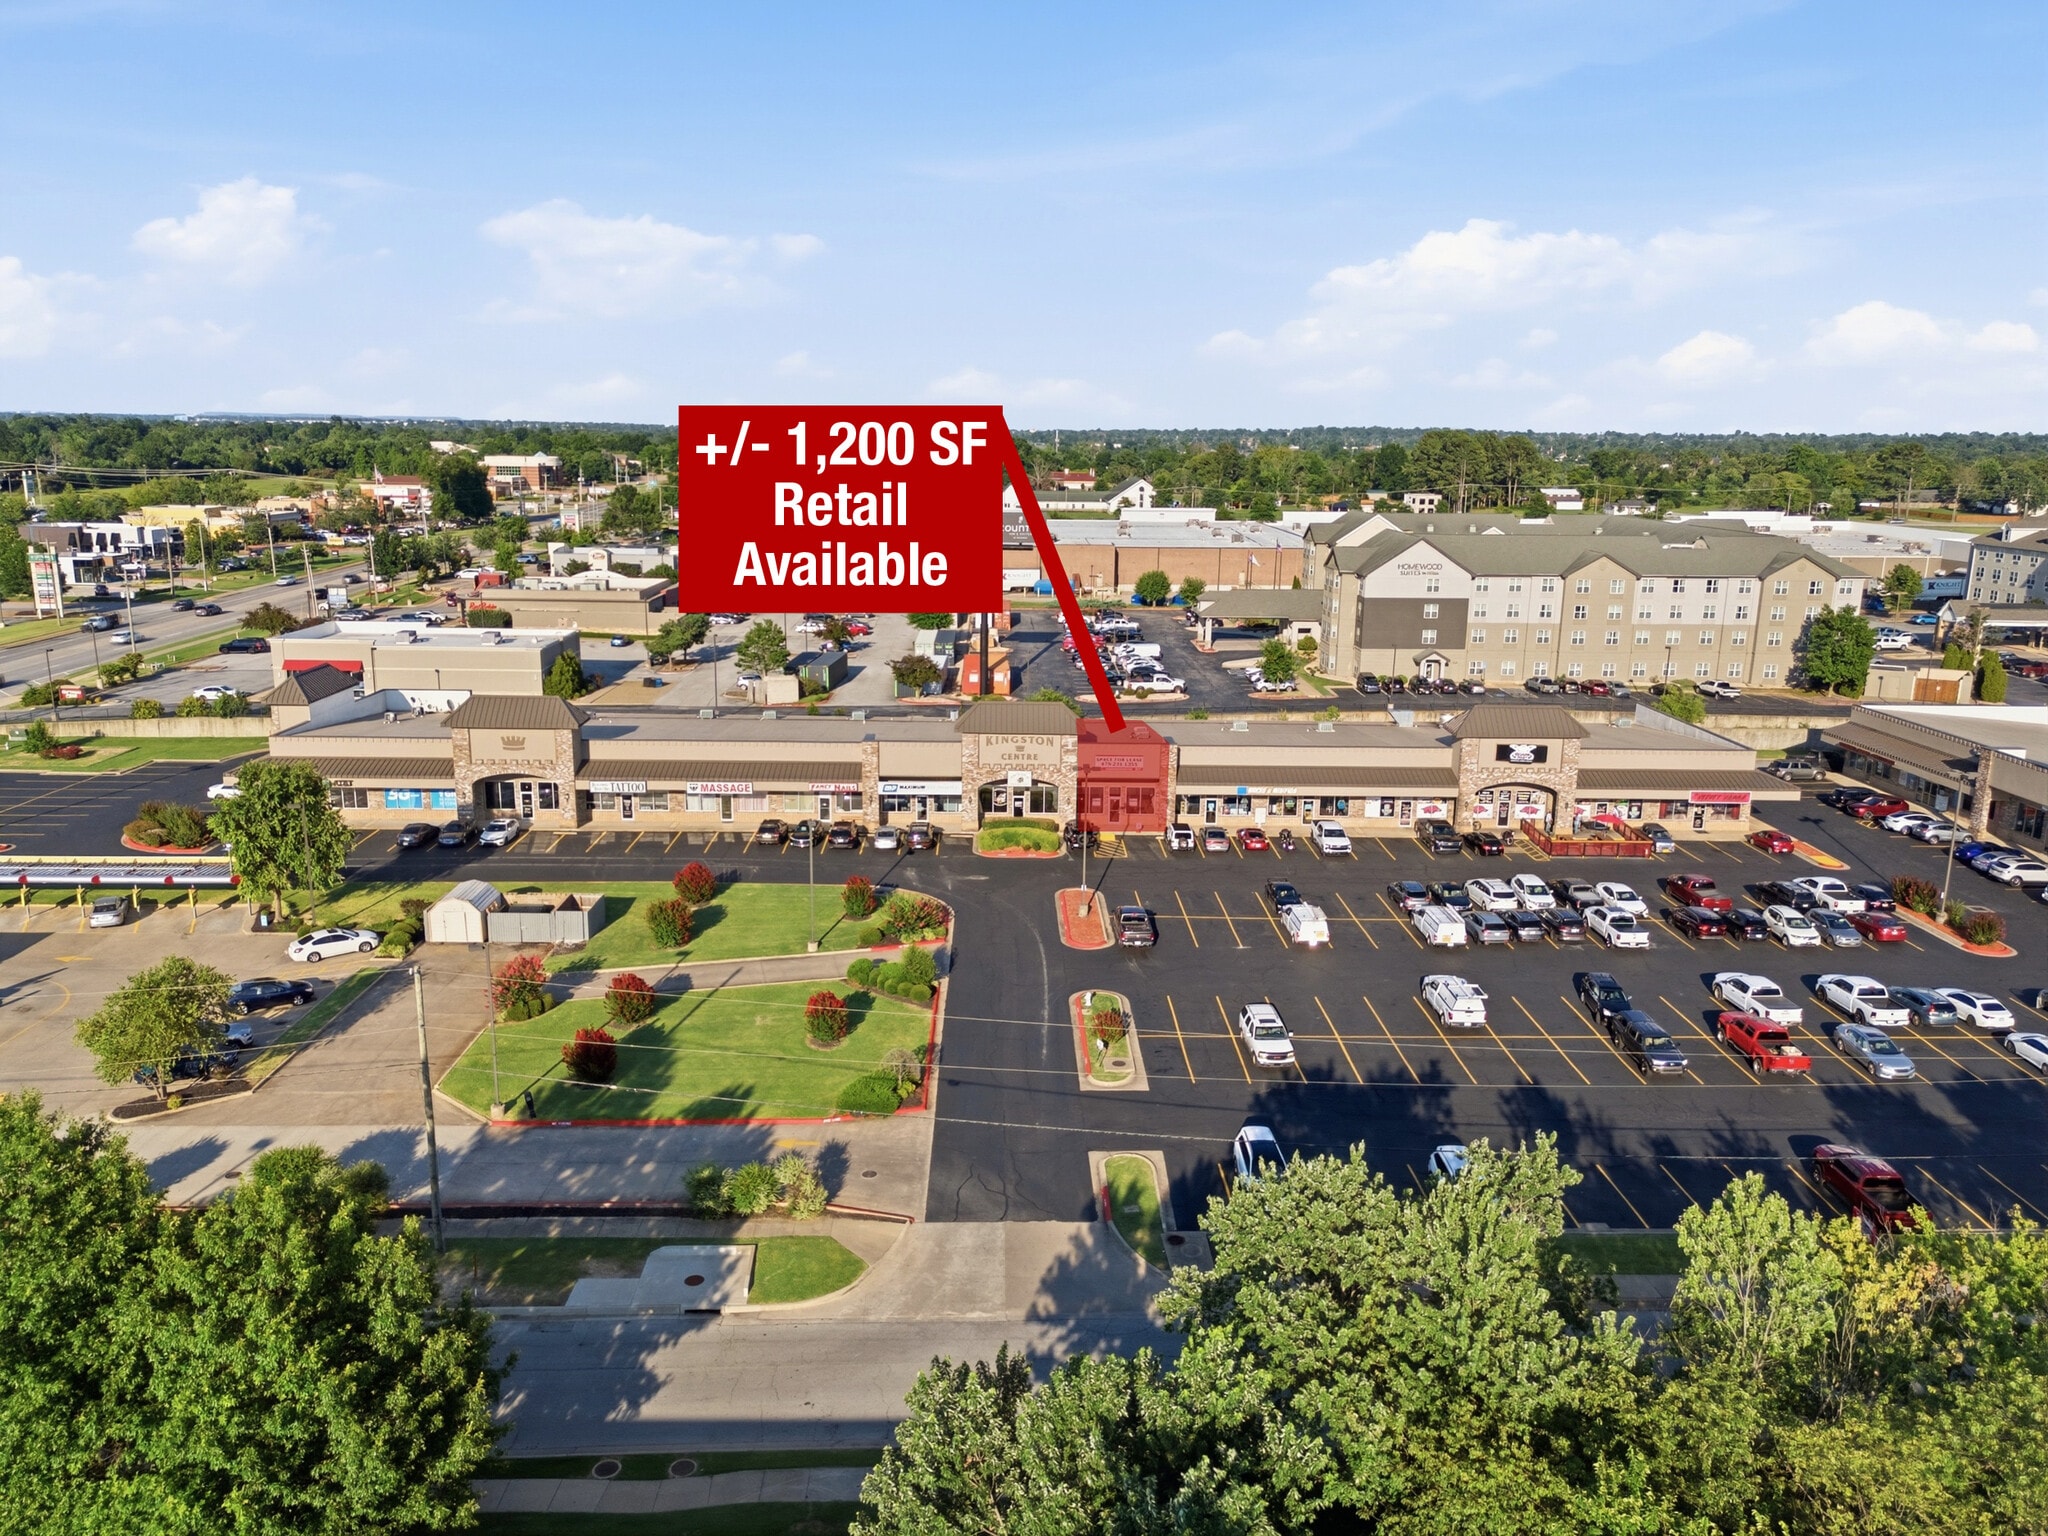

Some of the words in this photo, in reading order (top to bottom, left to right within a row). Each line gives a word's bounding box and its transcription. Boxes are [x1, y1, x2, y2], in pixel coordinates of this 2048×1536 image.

[985, 735, 1054, 747] KINGSTON
[610, 782, 645, 792] TATTOO
[700, 783, 750, 792] MASSAGE
